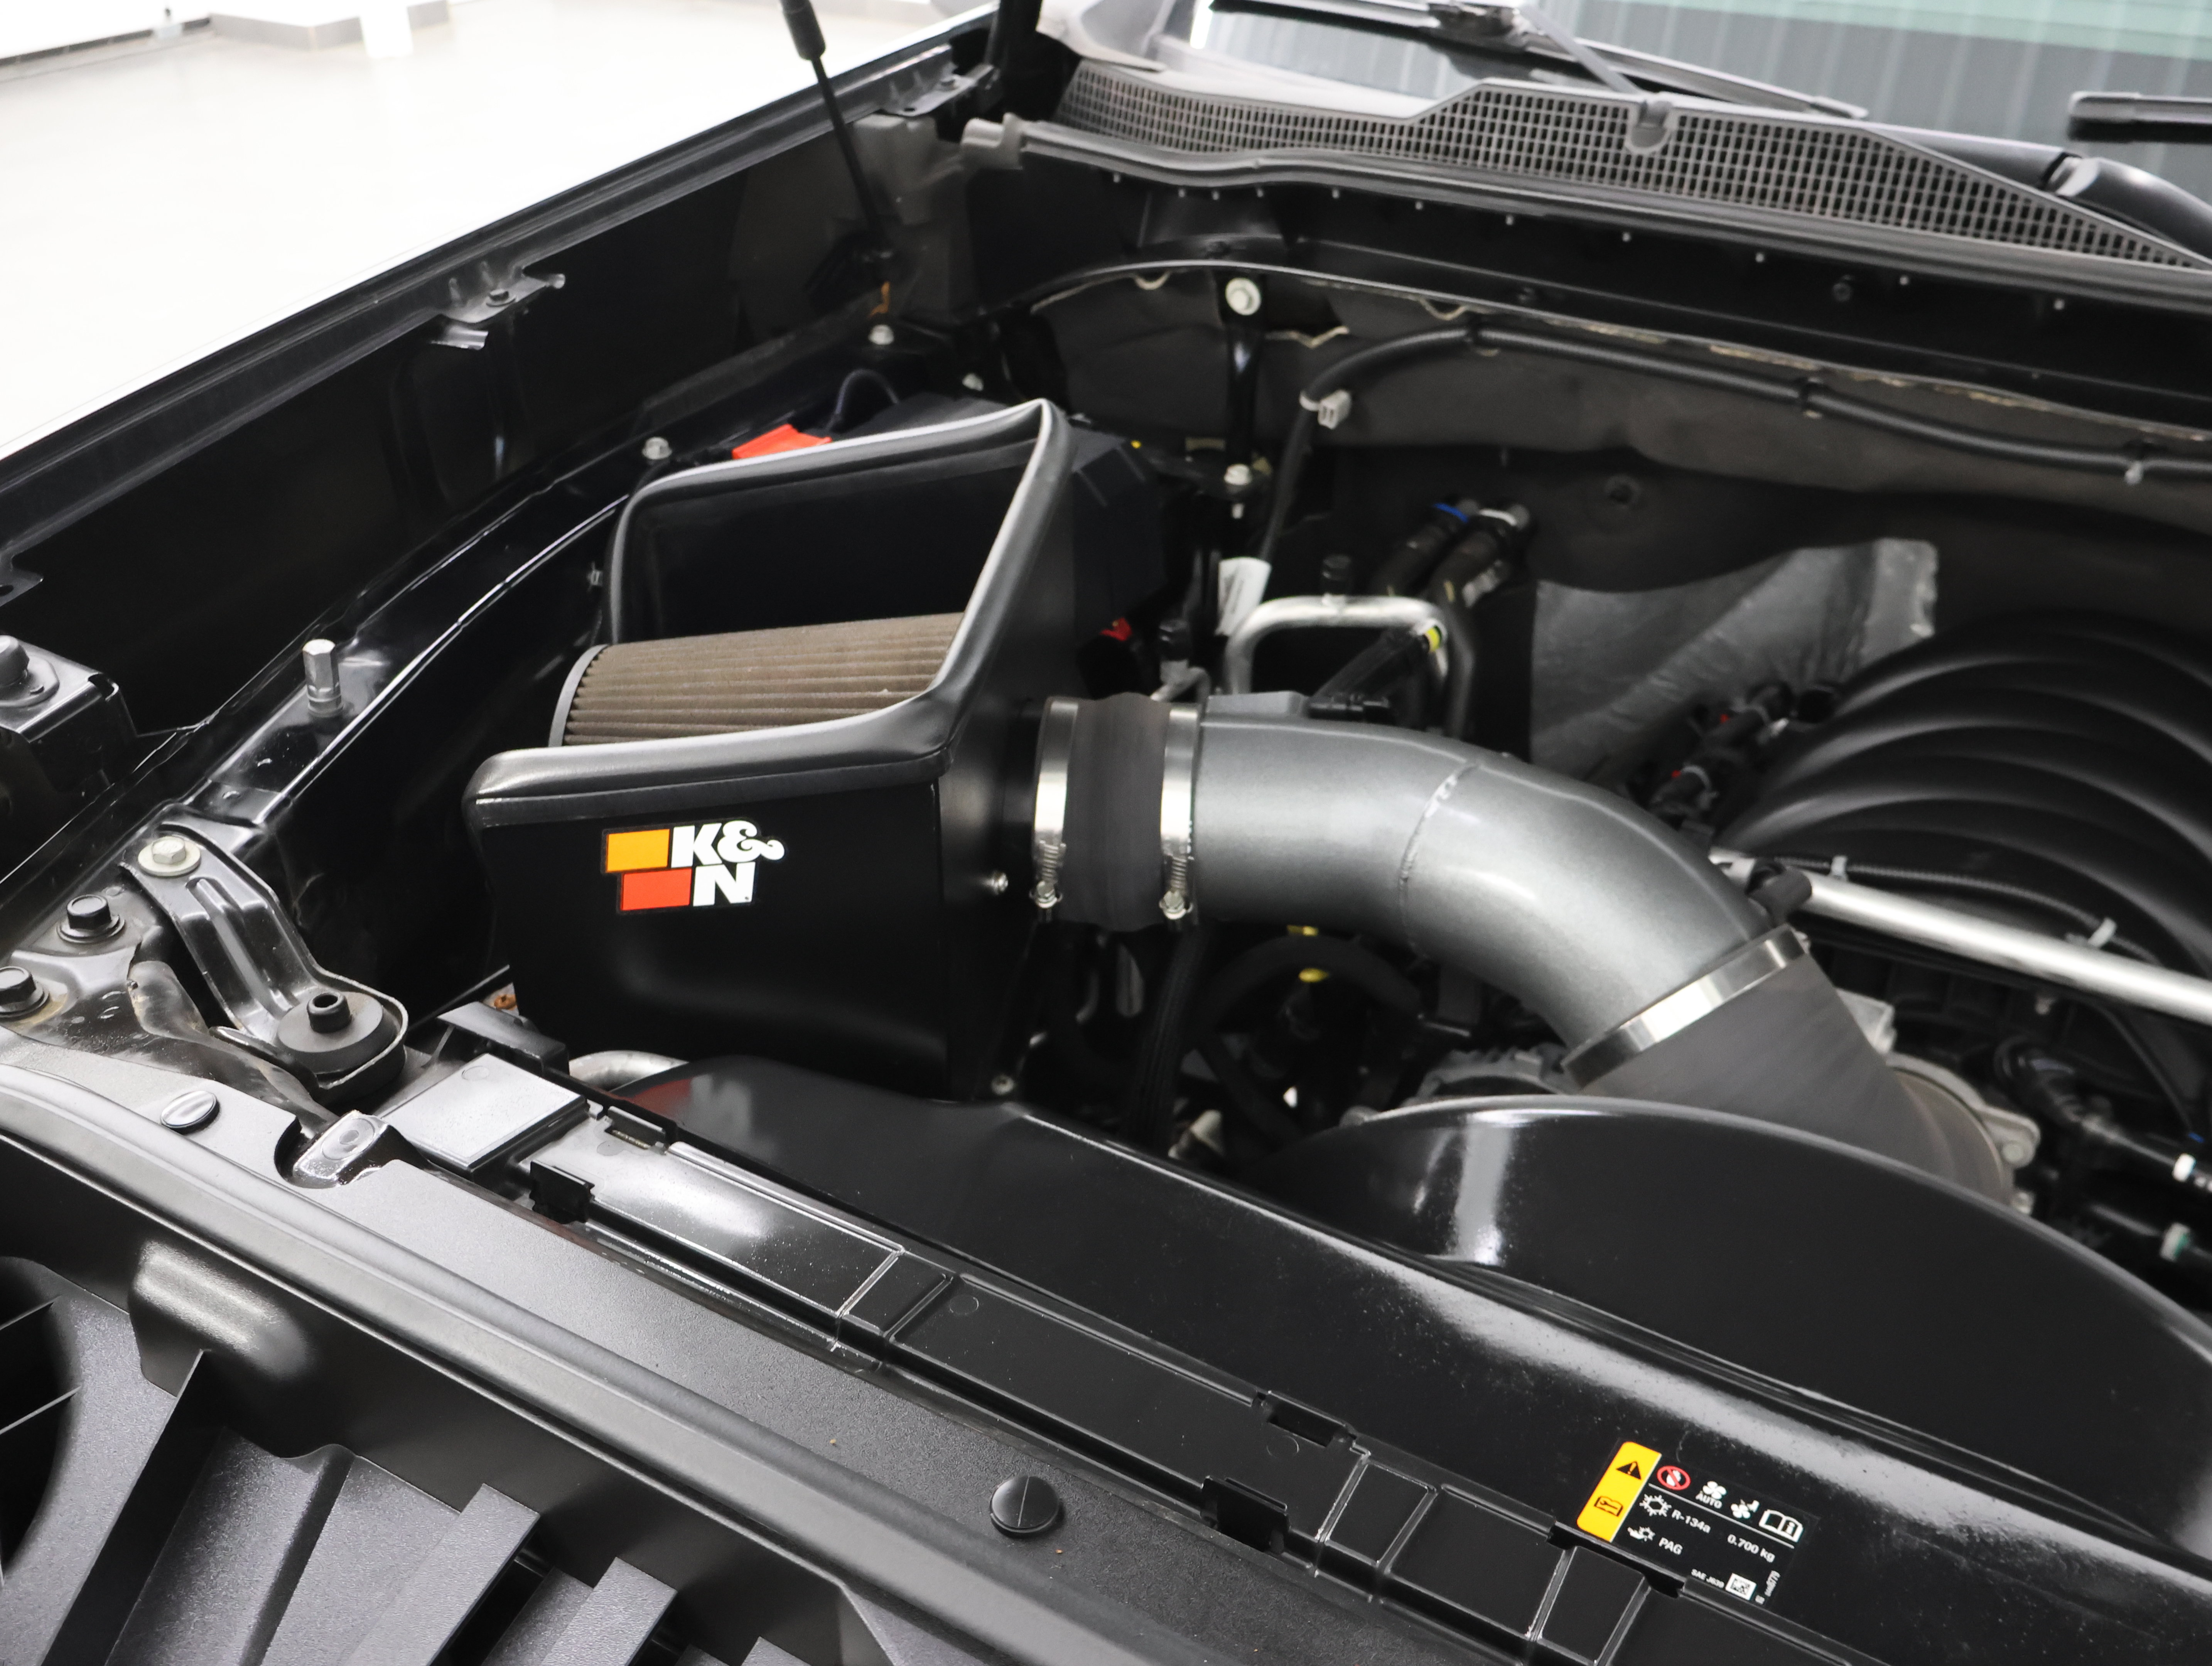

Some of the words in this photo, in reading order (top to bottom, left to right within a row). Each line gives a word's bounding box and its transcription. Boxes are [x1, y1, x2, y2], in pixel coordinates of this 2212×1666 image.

[1696, 1491, 1722, 1509] AUTO
[1672, 1509, 1711, 1533] R-134a
[1727, 1534, 1759, 1554] 0.700
[1760, 1548, 1775, 1563] kg
[1659, 1537, 1683, 1555] PAG
[1691, 1569, 1707, 1580] SAE
